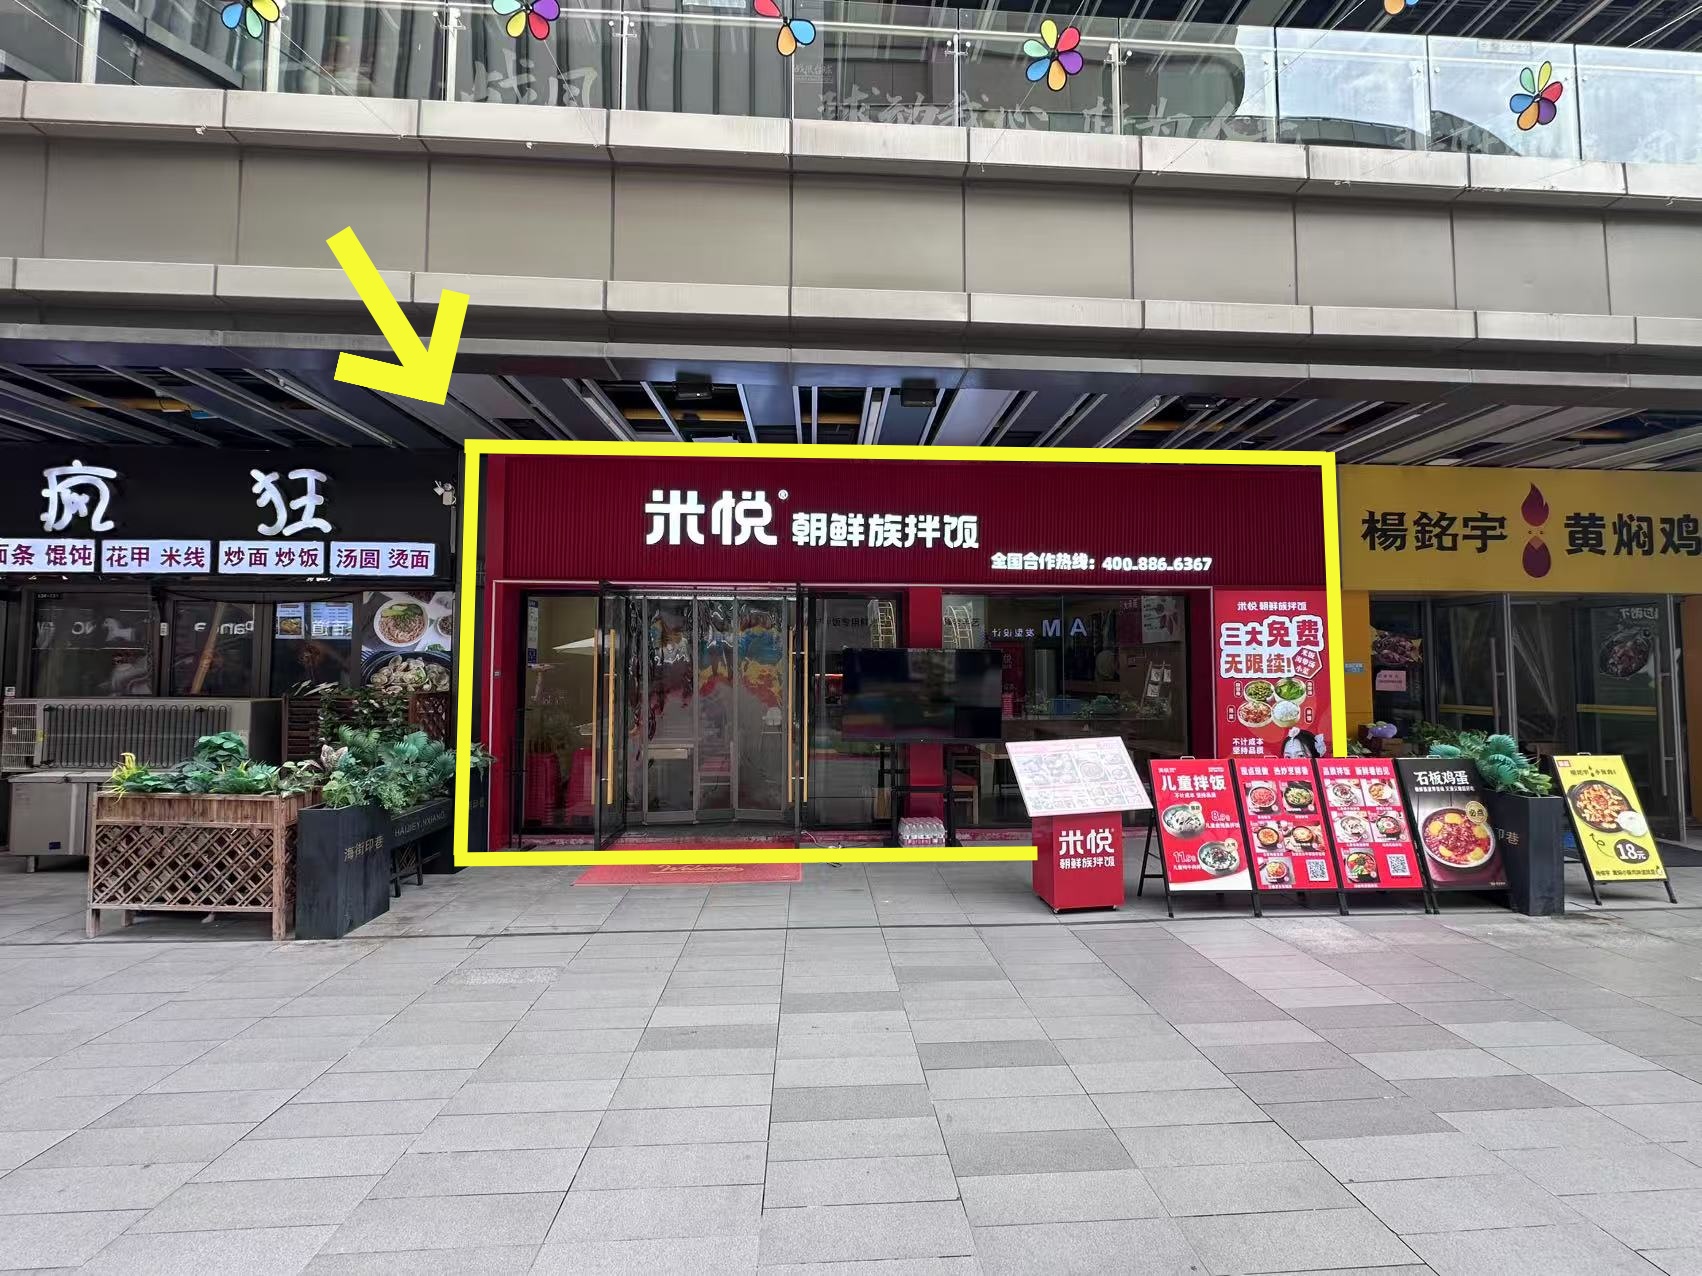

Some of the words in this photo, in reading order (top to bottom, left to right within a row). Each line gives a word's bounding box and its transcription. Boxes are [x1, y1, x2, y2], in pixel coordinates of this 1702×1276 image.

[40, 460, 116, 532] 疯
[249, 468, 333, 536] 狂
[645, 489, 778, 546] 米悦
[792, 512, 979, 548] 朝鲜族拌饭
[1360, 510, 1508, 553] 楊銘宇
[1564, 512, 1702, 556] 黄焖鸡
[45, 544, 93, 567] 馄饨
[106, 546, 150, 567] 花甲
[160, 546, 205, 568] 米线
[224, 547, 269, 567] 炒面
[275, 547, 319, 568] 炒饭
[336, 548, 380, 569] 汤圆
[388, 548, 431, 569] 烫面
[991, 552, 1095, 571] 全国合作热线：
[1620, 607, 1658, 619] 下饭过
[1224, 620, 1320, 647] 三大免费
[1225, 653, 1292, 674] 无限续!
[1232, 737, 1264, 746] 不计成本
[1161, 774, 1227, 792] 儿童拌饭
[1413, 770, 1470, 786] 石板鸡蛋
[1059, 828, 1114, 856] 米悦
[1616, 843, 1647, 861] 18元
[1059, 855, 1116, 870] 朝鲜族拌饭
